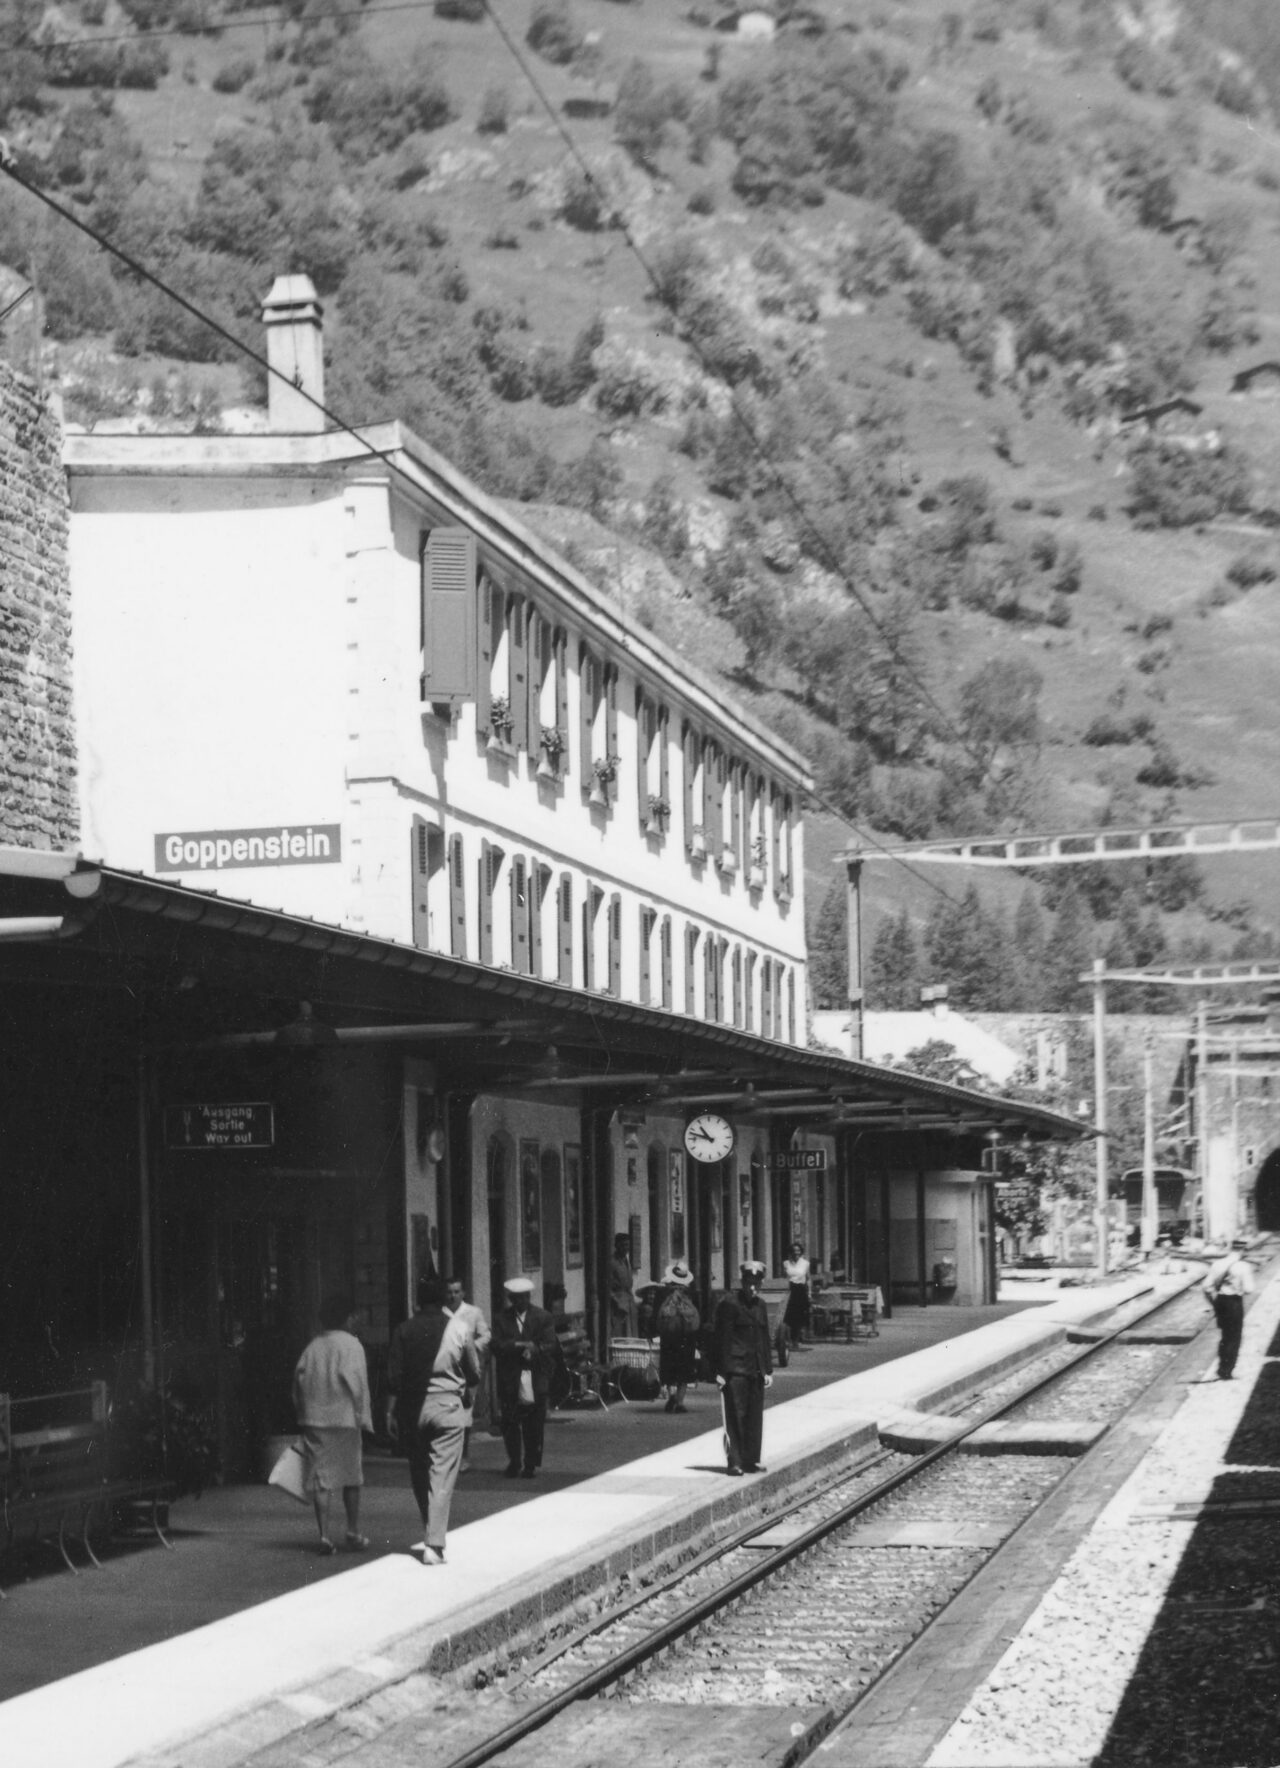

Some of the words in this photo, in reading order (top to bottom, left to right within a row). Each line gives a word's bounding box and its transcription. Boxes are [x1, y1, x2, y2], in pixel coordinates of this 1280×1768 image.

[165, 828, 330, 869] Goppenstein
[202, 1106, 253, 1120] Ausgang
[210, 1119, 245, 1130] Sortie
[205, 1133, 230, 1143] Way
[234, 1132, 252, 1143] out
[776, 1152, 820, 1168] Buffet
